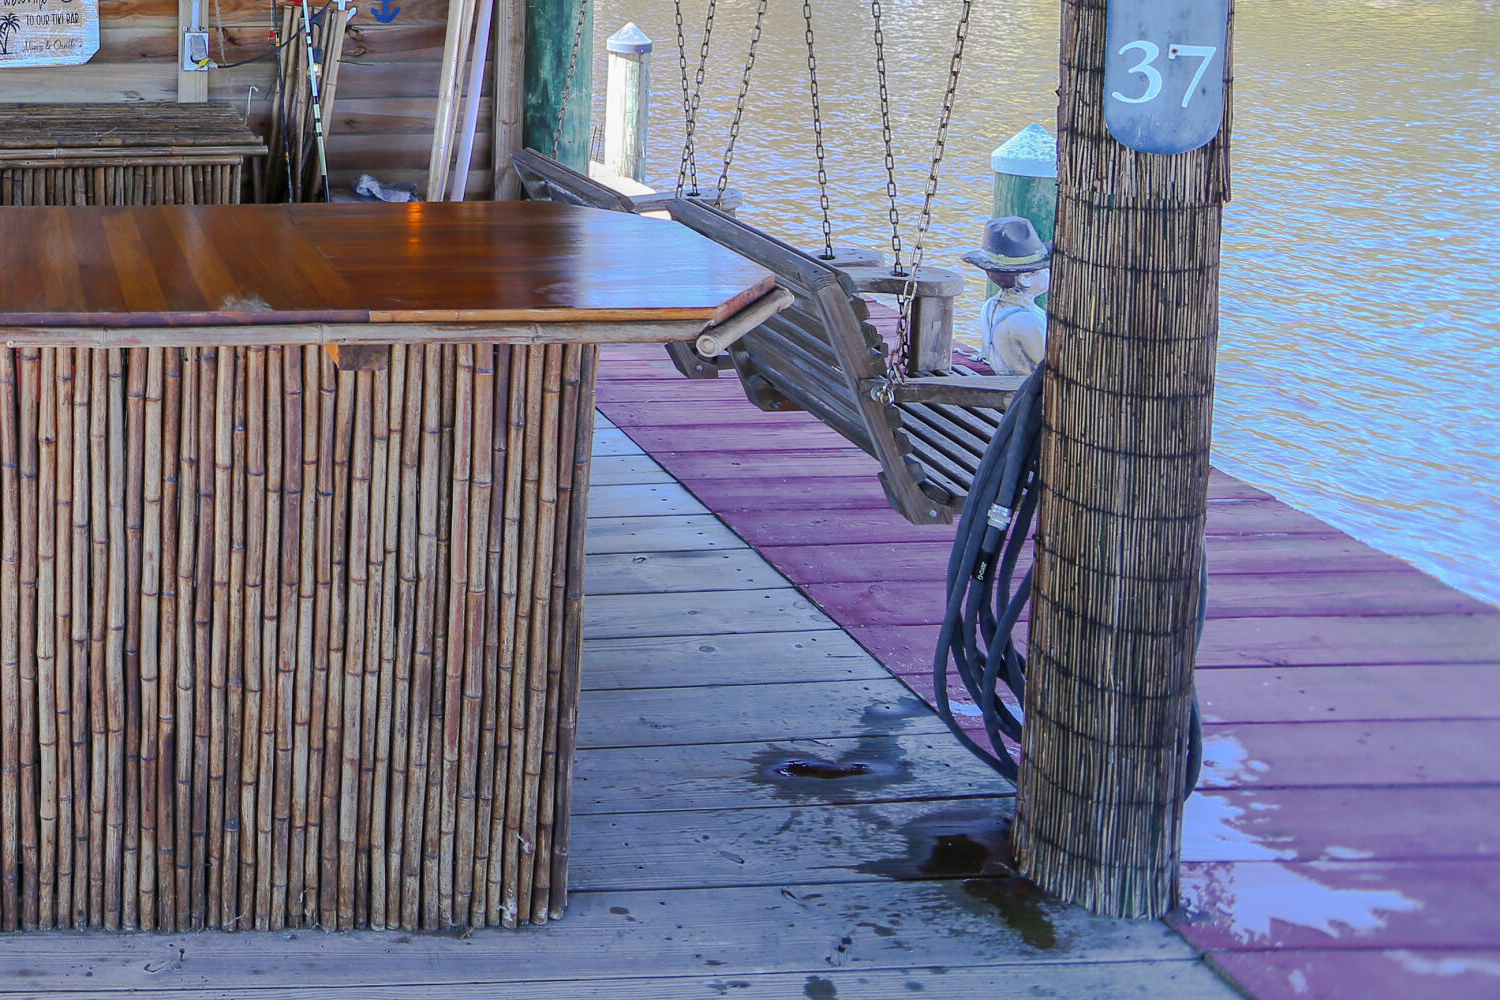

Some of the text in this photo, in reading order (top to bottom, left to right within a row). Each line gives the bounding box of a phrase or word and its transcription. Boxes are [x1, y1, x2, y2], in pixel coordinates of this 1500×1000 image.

[26, 12, 79, 26] TO OUR TIKI BAR
[1111, 40, 1217, 109] 37
